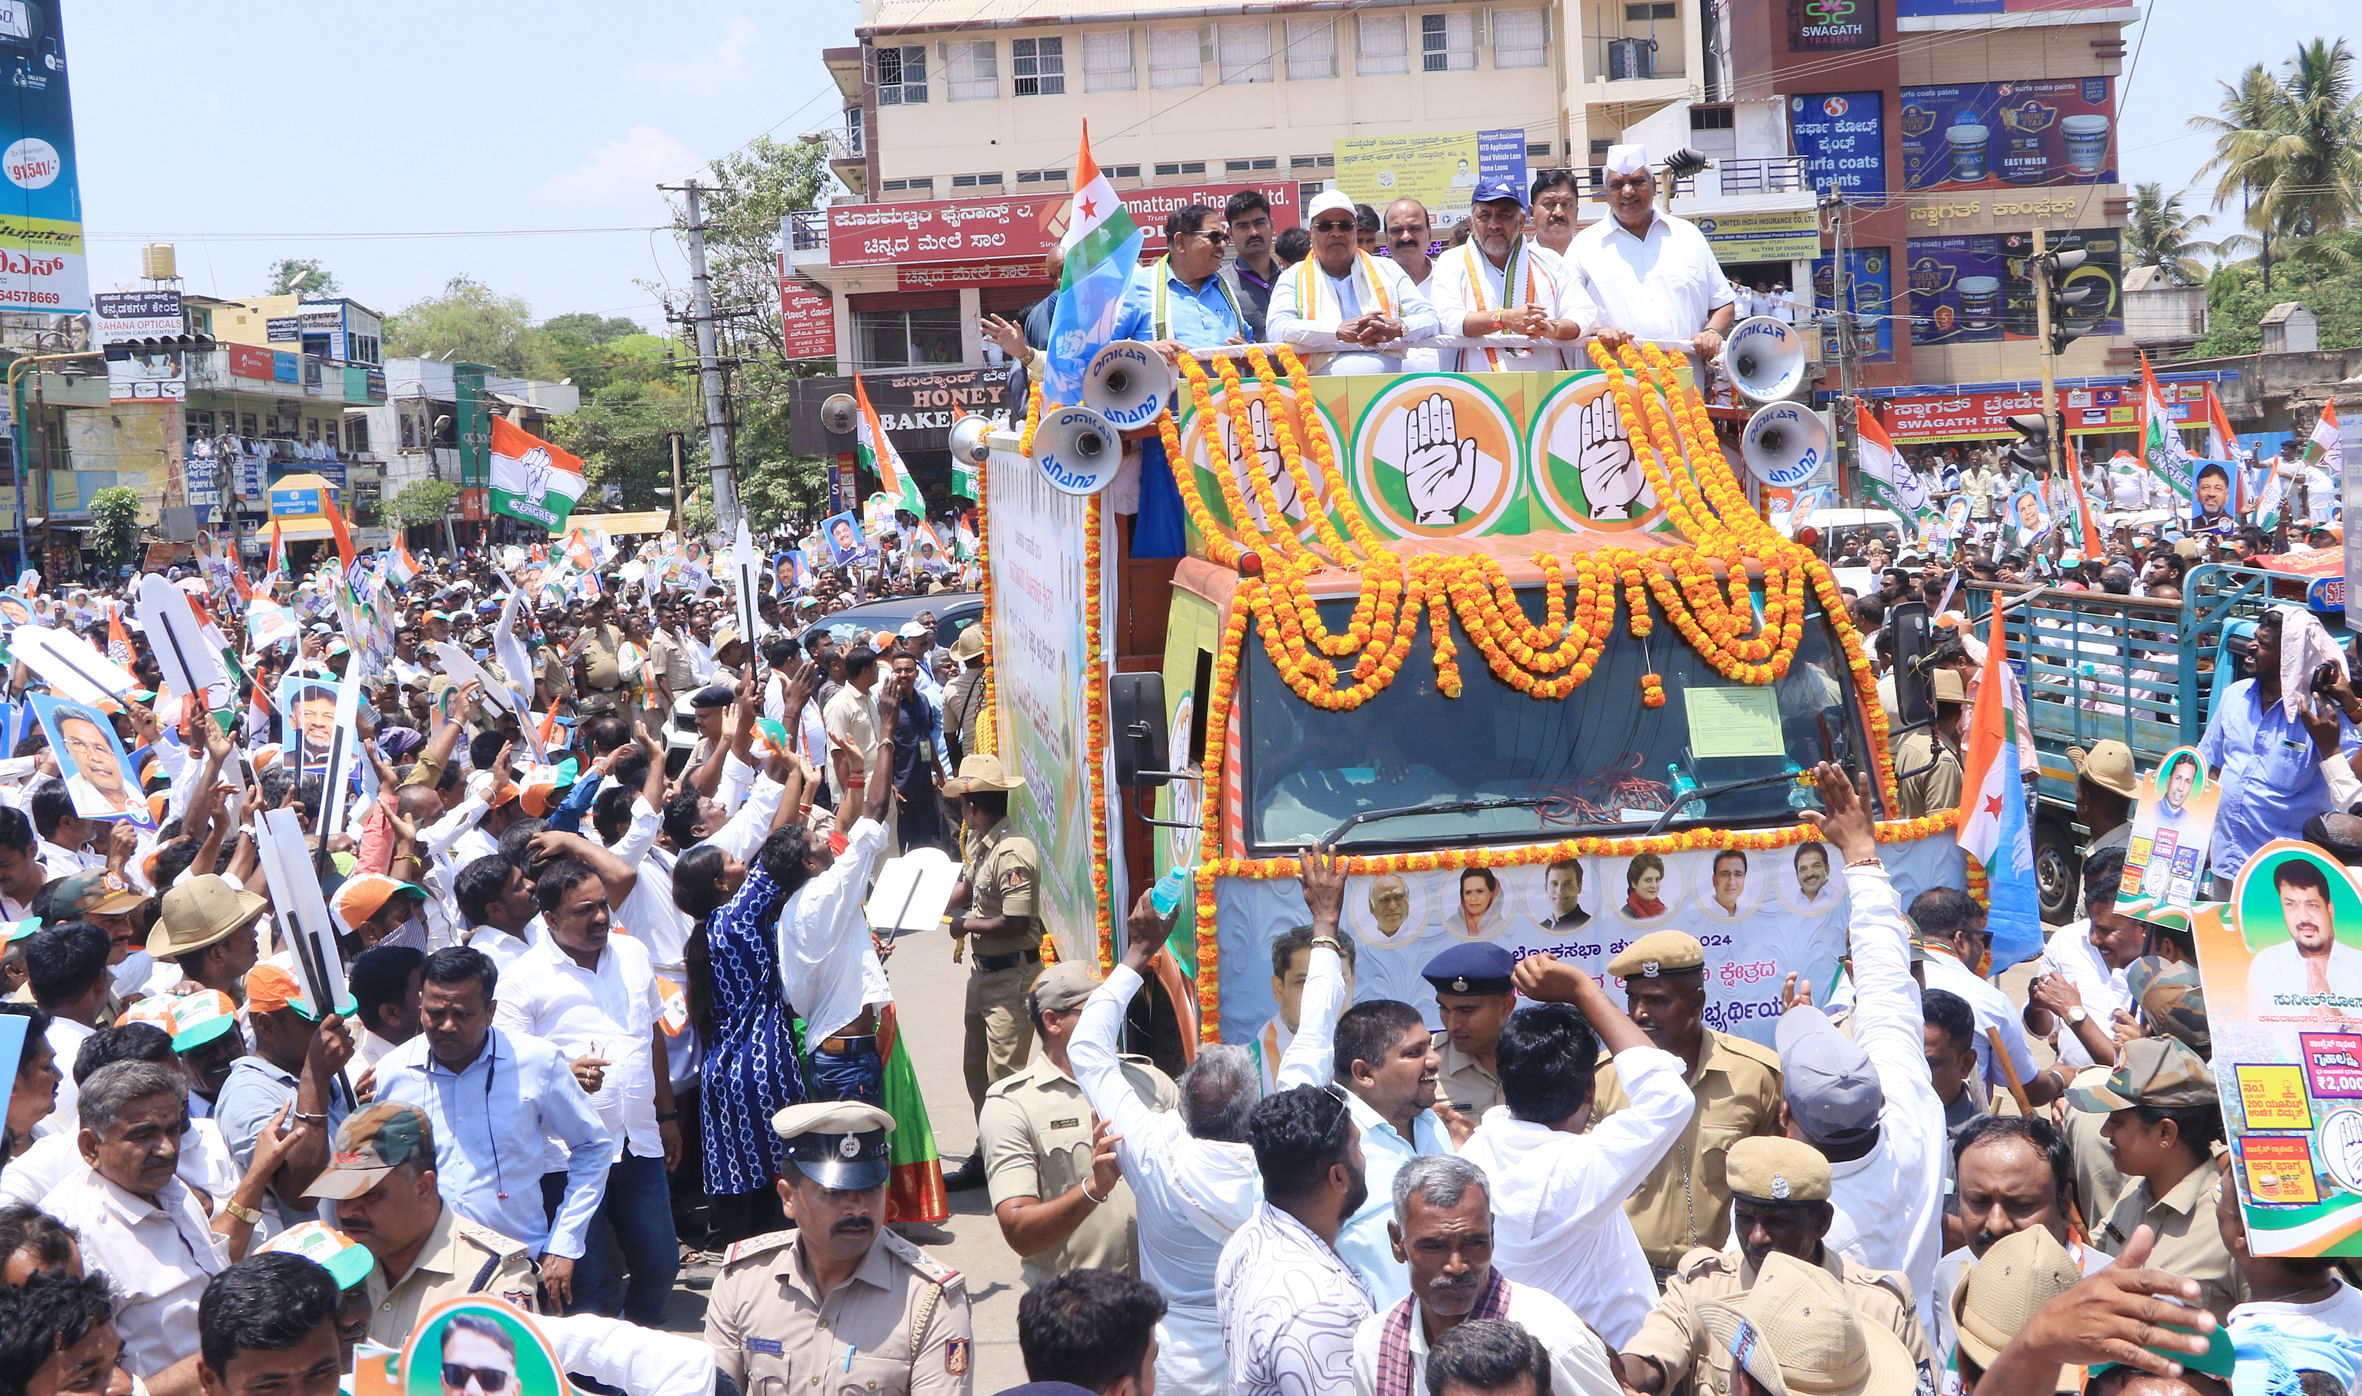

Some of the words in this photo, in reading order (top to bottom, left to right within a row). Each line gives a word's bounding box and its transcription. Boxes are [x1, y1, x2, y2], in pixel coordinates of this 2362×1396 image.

[1802, 24, 1862, 37] SWAGATH
[1809, 34, 1857, 45] TRADERS
[1479, 144, 1490, 152] RTO
[1490, 143, 1518, 151] Applications
[1479, 154, 1492, 162] Used
[1807, 156, 1835, 170] urfa
[1838, 155, 1879, 169] coats
[2004, 158, 2023, 167] EASY
[2023, 156, 2048, 166] WASH
[1815, 173, 1861, 191] paints
[1121, 195, 1189, 215] amattam
[1192, 190, 1232, 210] Finan
[1146, 214, 1168, 222] Trust
[1719, 219, 1741, 227] UNITED
[1759, 217, 1793, 225] INSURANCE
[1909, 200, 1981, 227] ಸ್ವಾಗತ್
[863, 235, 910, 257] ಚಿನ್ನದ
[917, 231, 962, 251] ಮೇಲೆ
[970, 230, 1006, 248] ಸಾಲ
[97, 320, 136, 332] SAHANA
[137, 319, 183, 331] OPTICALS
[1732, 322, 1786, 352] OMKAR
[1093, 348, 1148, 378] OMKAR
[912, 386, 1005, 408] HONEY
[1894, 397, 1972, 418] ಸ್ವಾಗತ್
[1103, 393, 1158, 424] ANAND
[1060, 413, 1113, 448] OMKAR
[1750, 408, 1800, 444] OMKAR
[1897, 417, 1977, 430] SWAGATH
[1981, 415, 2008, 426] TRA
[1041, 453, 1098, 489] ANAND
[1769, 447, 1818, 483] ANAND
[1698, 934, 1733, 948] 024
[1719, 959, 1777, 987] ಕ್ಷೇತ್ರದ
[1700, 999, 1784, 1031] ಭ್ಯರ್ಥಿಯ
[2247, 1099, 2264, 1108] 200
